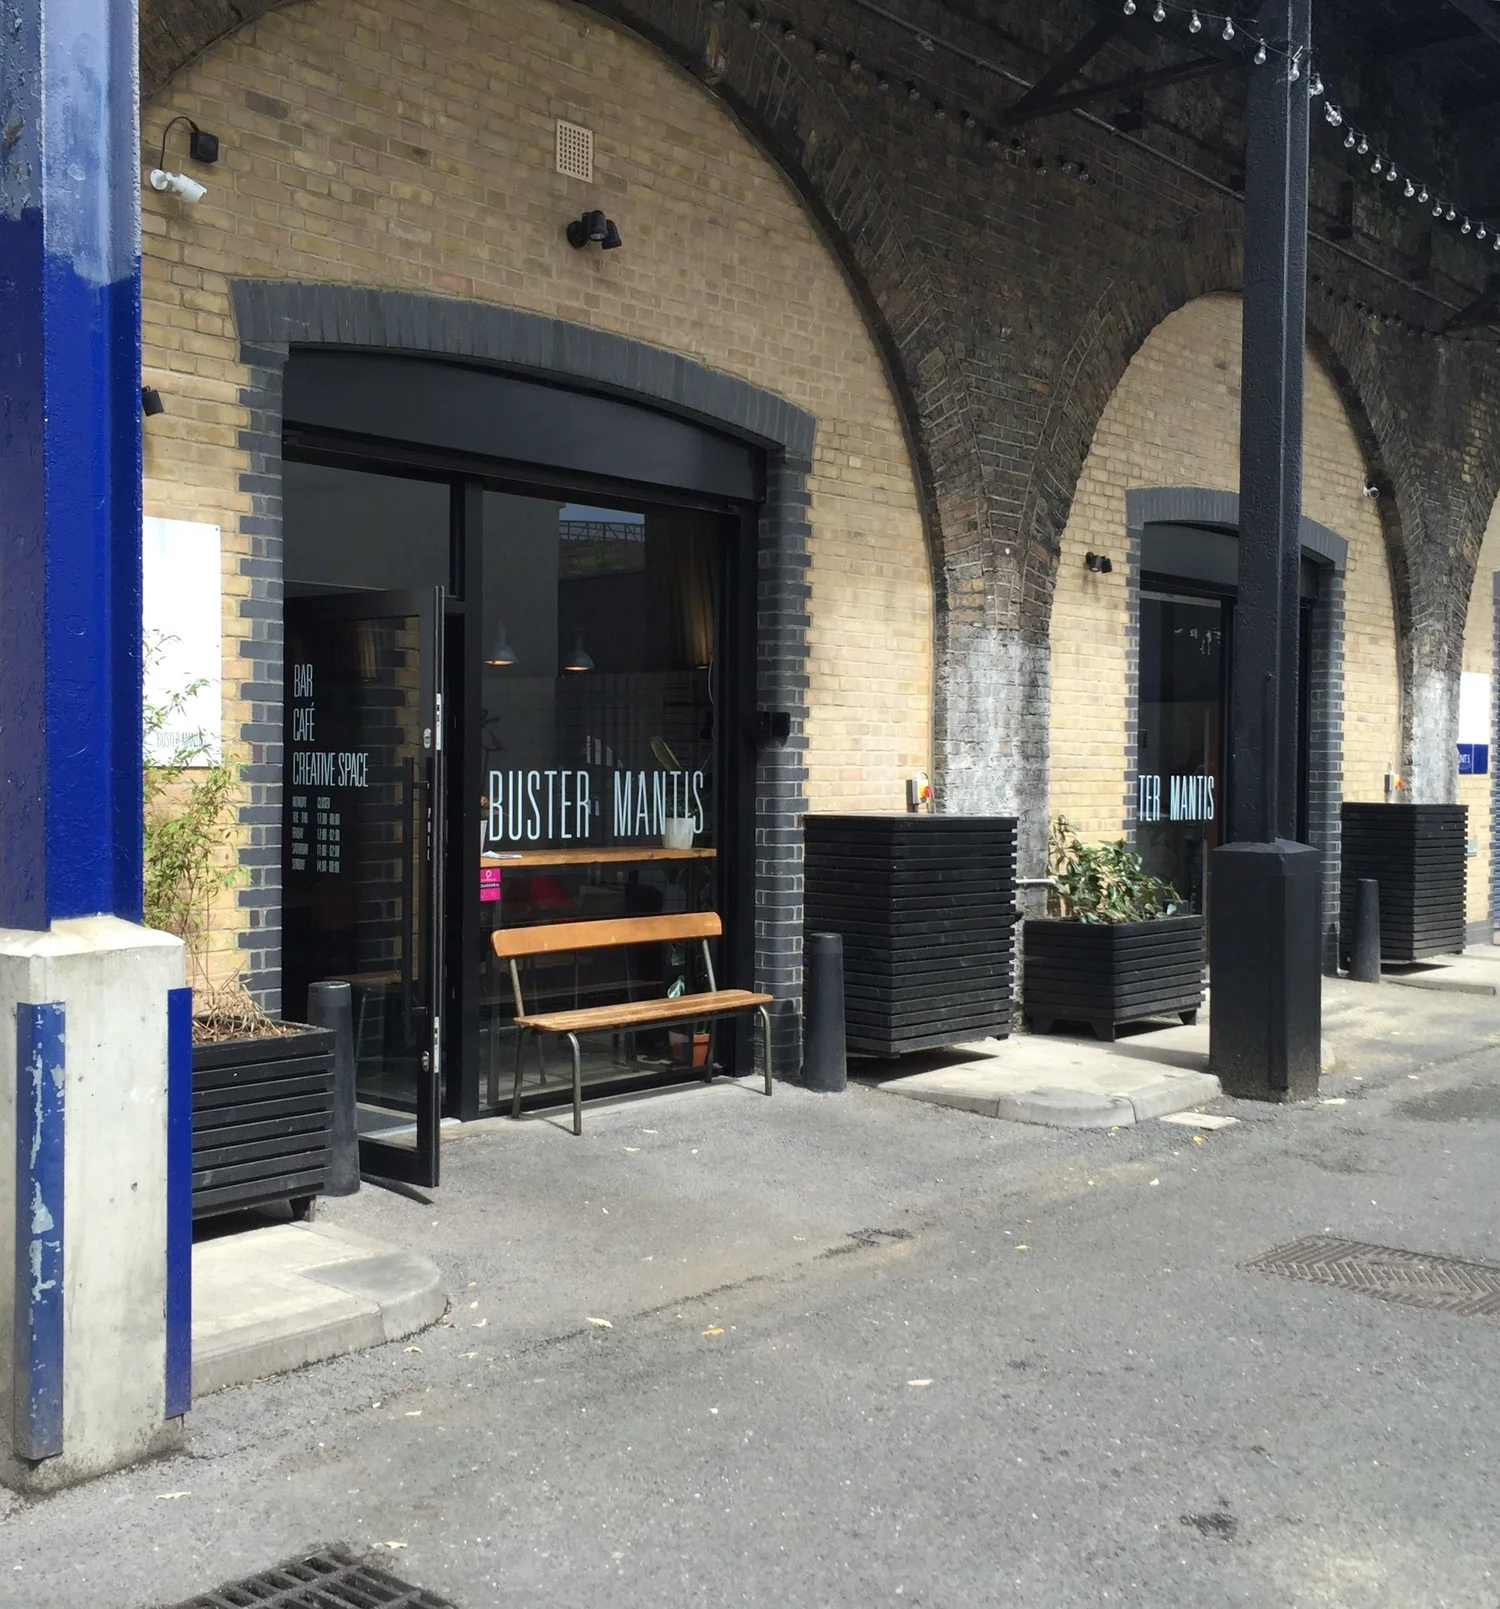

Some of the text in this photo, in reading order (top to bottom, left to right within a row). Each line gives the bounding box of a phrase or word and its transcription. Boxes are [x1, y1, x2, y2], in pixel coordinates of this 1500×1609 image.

[294, 664, 313, 698] BAR
[293, 702, 316, 742] CAFÉ
[292, 752, 369, 788] CREATIVE SPACE
[489, 770, 704, 842] BUSTER MANTIS
[1169, 775, 1215, 821] MANTIS
